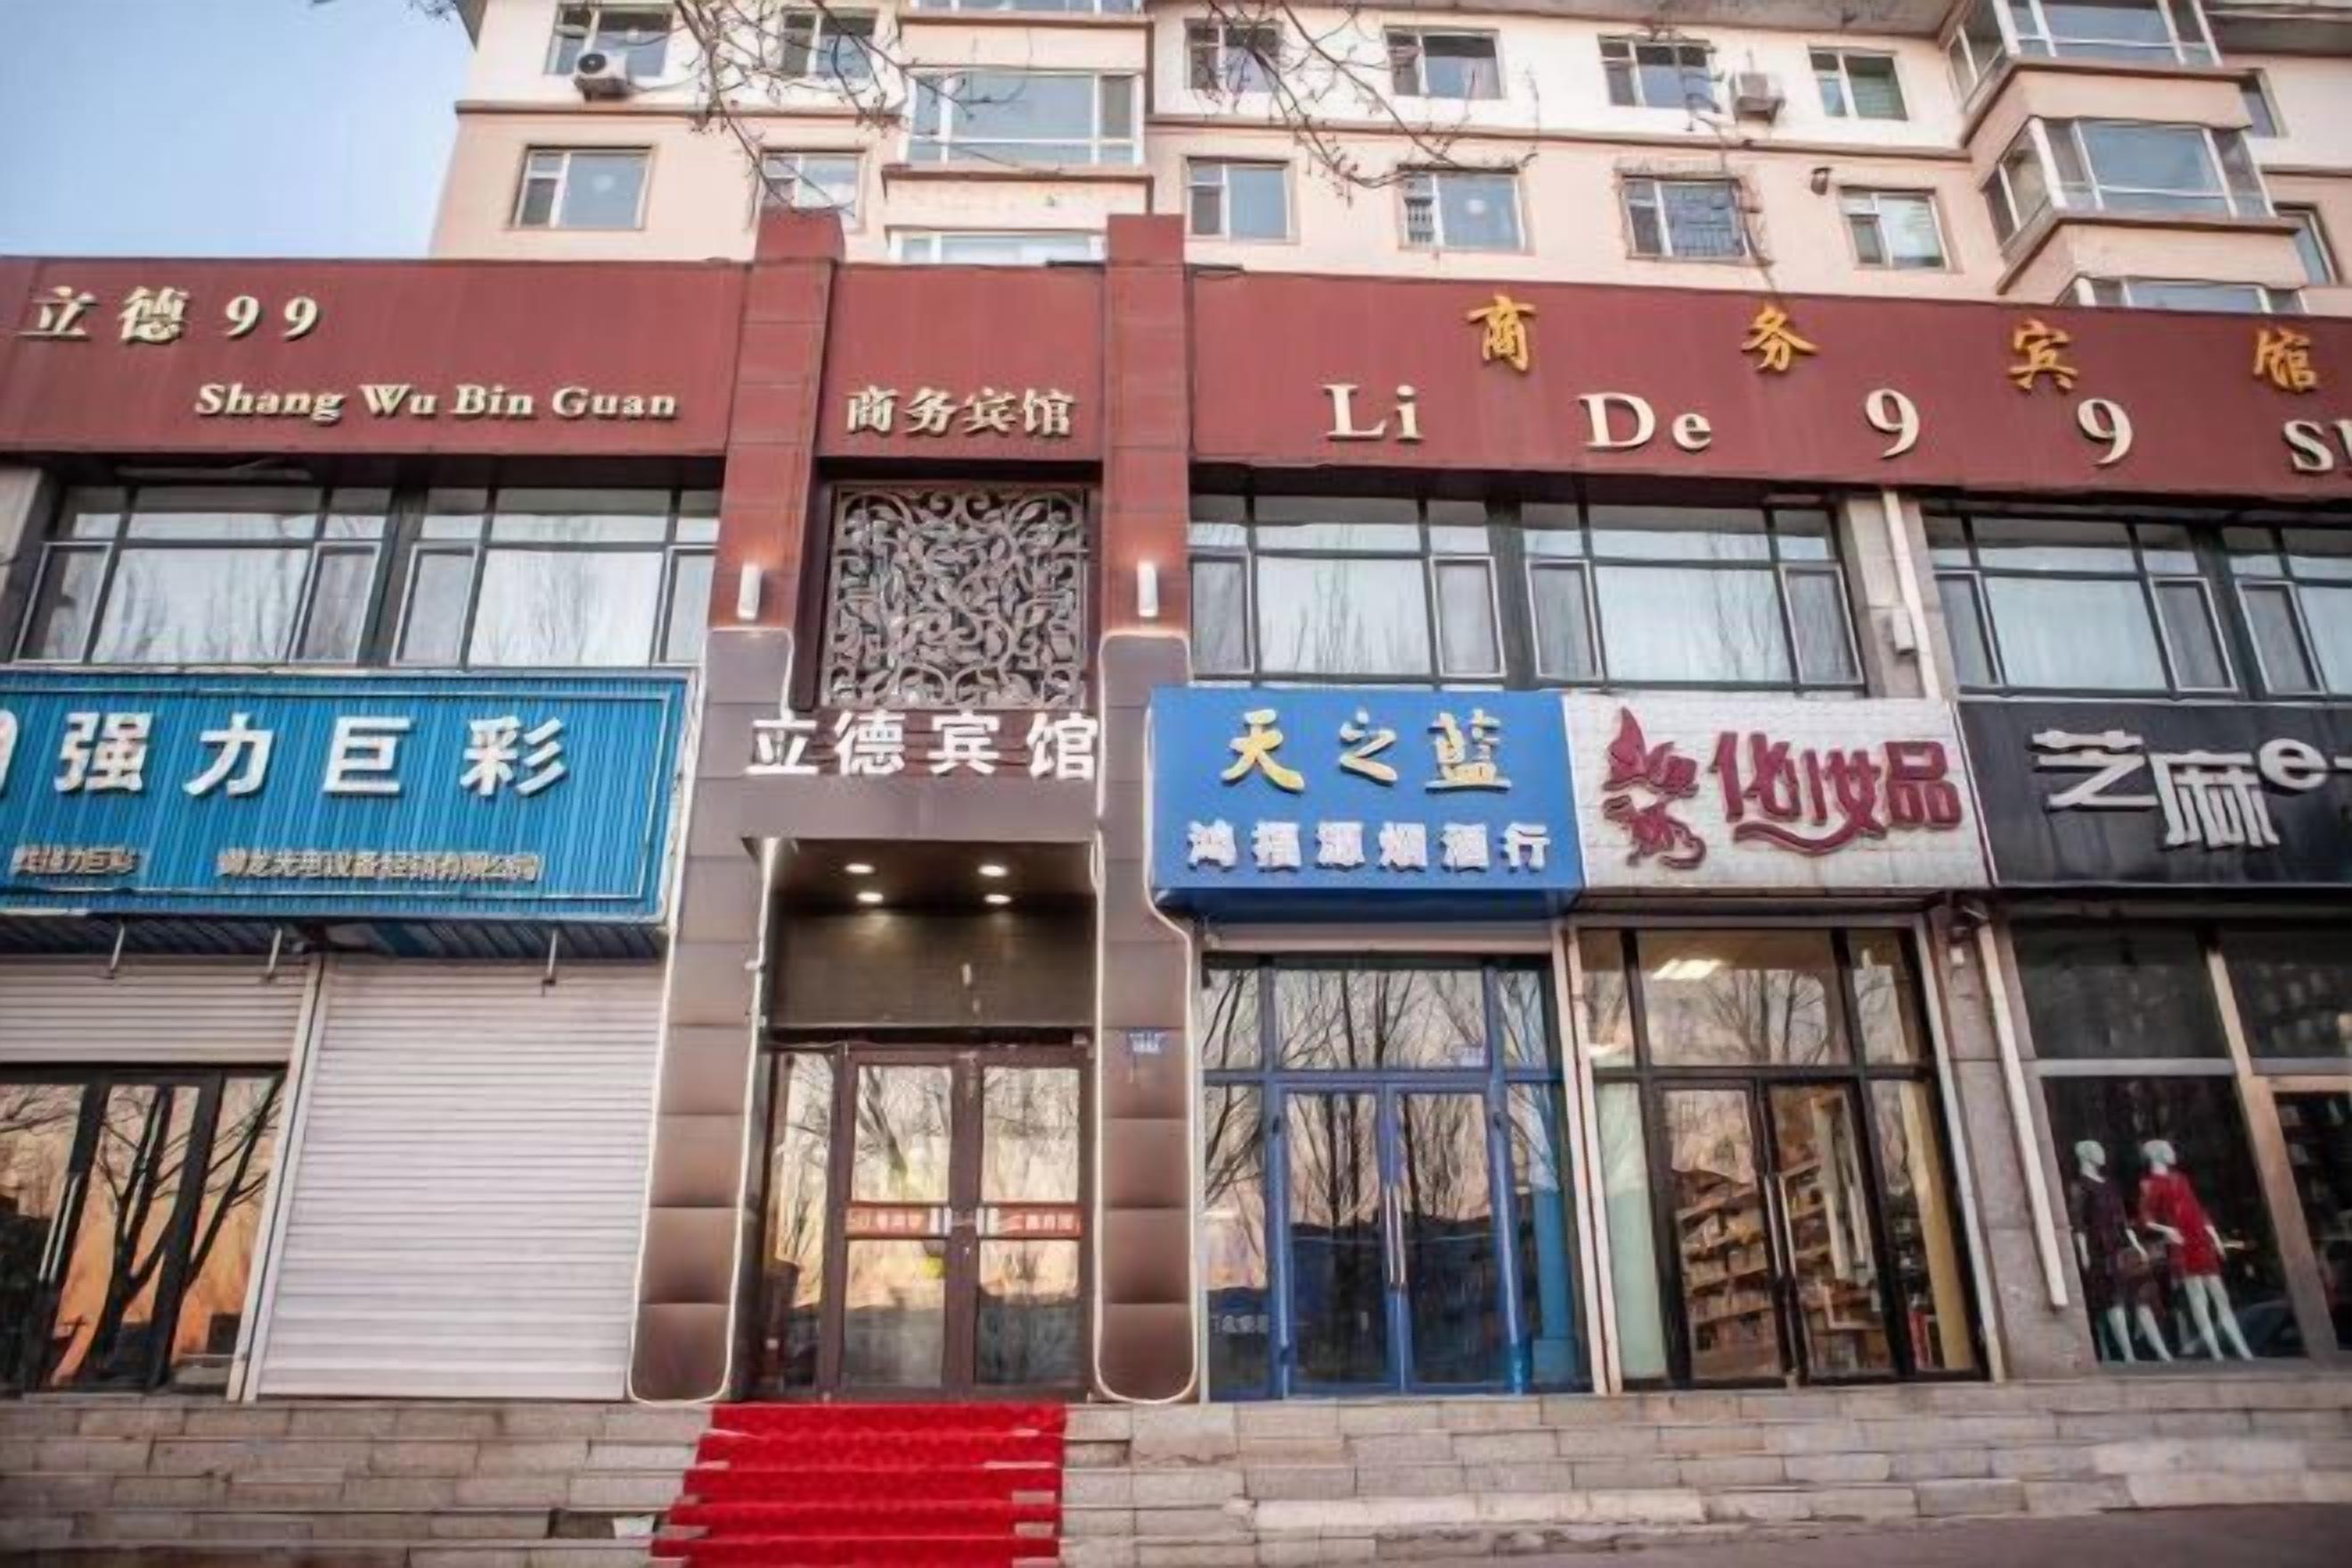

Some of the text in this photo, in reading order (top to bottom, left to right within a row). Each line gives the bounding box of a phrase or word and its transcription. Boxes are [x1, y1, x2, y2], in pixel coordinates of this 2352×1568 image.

[194, 382, 678, 425] Shang Wu Bin Guan
[845, 385, 1075, 438] 商务宾馆
[1321, 383, 1423, 442] Li
[1579, 392, 1713, 452] De
[53, 711, 568, 797] 强力巨彩
[746, 711, 1099, 781] 立德宾馆
[1221, 707, 1513, 793] 天之蓝
[1709, 729, 1962, 857] 化妆品
